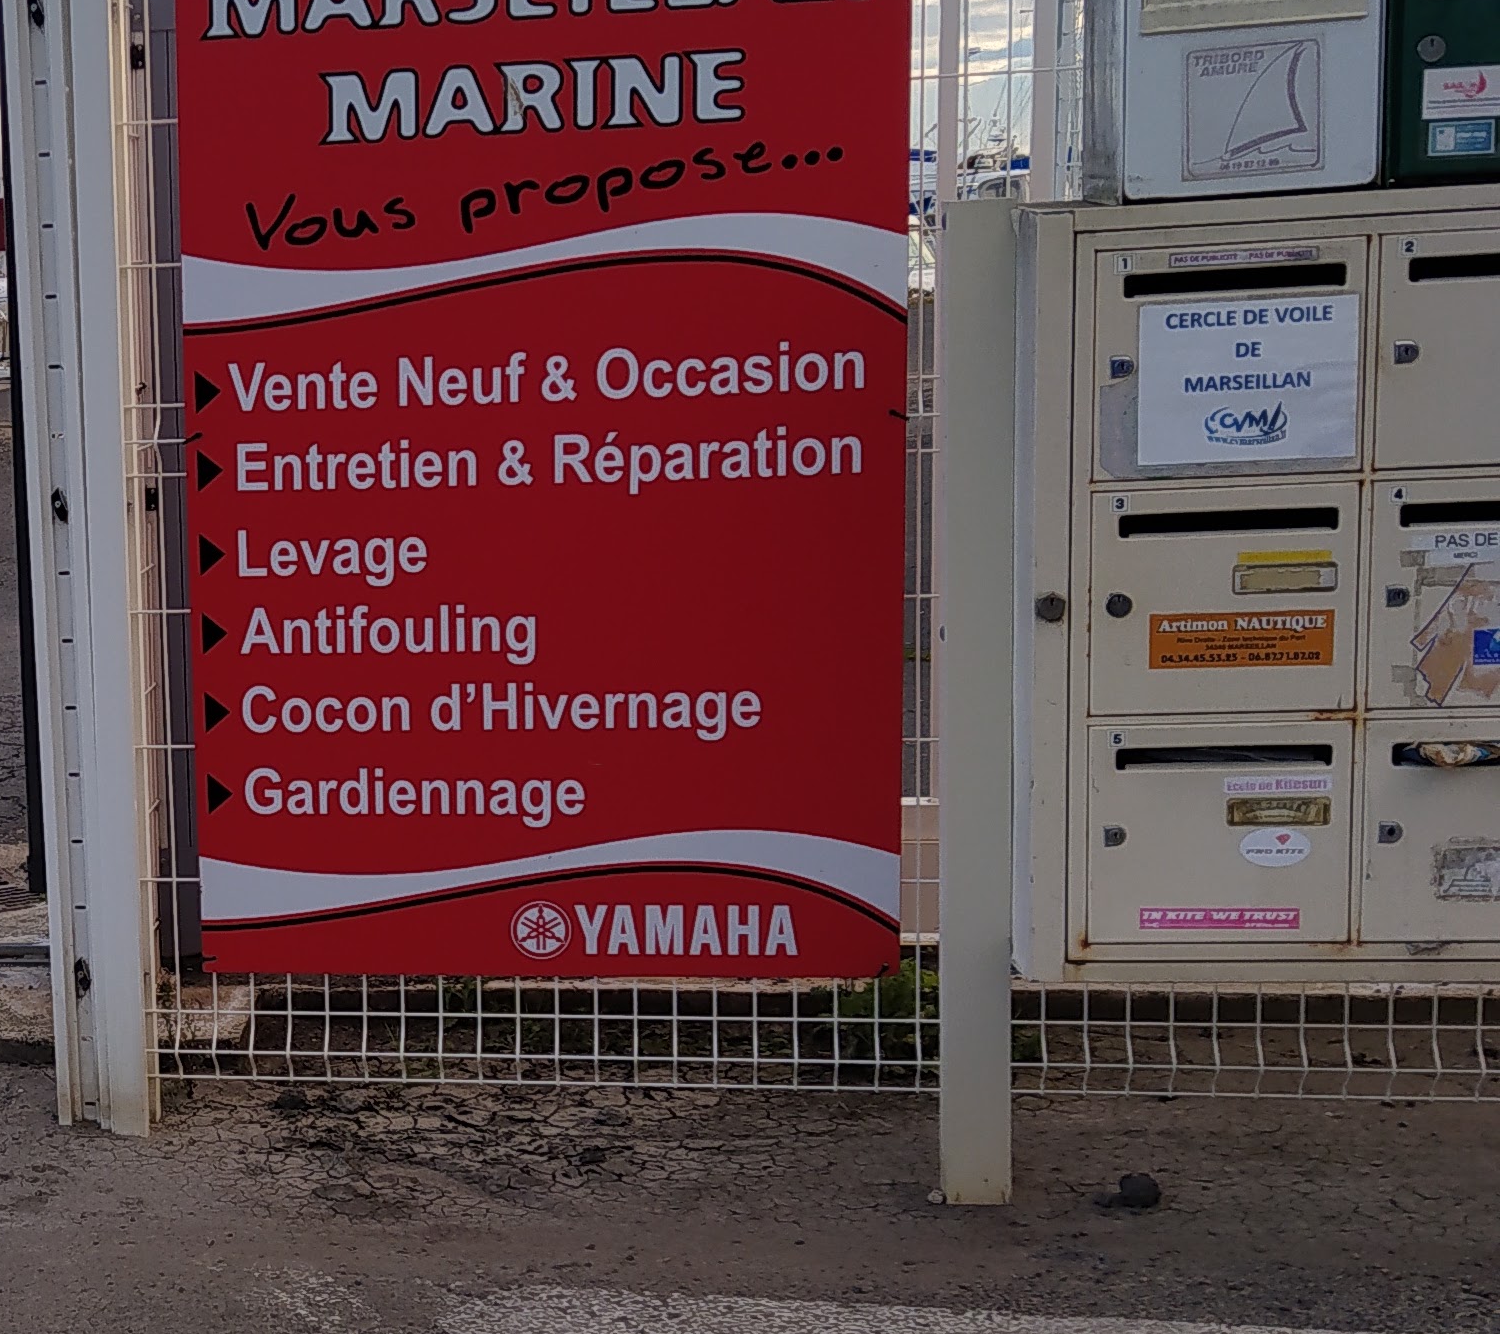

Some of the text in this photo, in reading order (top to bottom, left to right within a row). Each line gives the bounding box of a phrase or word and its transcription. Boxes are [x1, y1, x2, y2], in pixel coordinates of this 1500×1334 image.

[1193, 50, 1265, 67] TRIBORD
[1200, 62, 1258, 77] AMURE
[319, 48, 746, 145] MARINE
[245, 142, 843, 250] Vous propose...
[1404, 241, 1414, 253] 2
[1121, 258, 1128, 269] 1
[1165, 305, 1334, 329] CERCLE DE VOILE
[1235, 342, 1262, 358] DE
[228, 342, 865, 412] Vente Neuf & Occasion
[1184, 371, 1311, 393] MARSEILLAN
[236, 427, 862, 495] Entretien & Réparation
[1394, 488, 1403, 499] 4
[1115, 498, 1125, 510] 3
[1435, 533, 1498, 548] PAS DE
[237, 529, 427, 587] Levage
[1158, 616, 1327, 632] Artimon NAUTIQUE
[240, 605, 537, 665] Antifouling
[242, 683, 761, 740] Cocon d'Hivernage
[1112, 733, 1122, 745] 5
[244, 768, 585, 828] Gardiennage
[1142, 911, 1298, 920] IN KITE WE TRUST
[574, 904, 798, 956] YAMAHA
